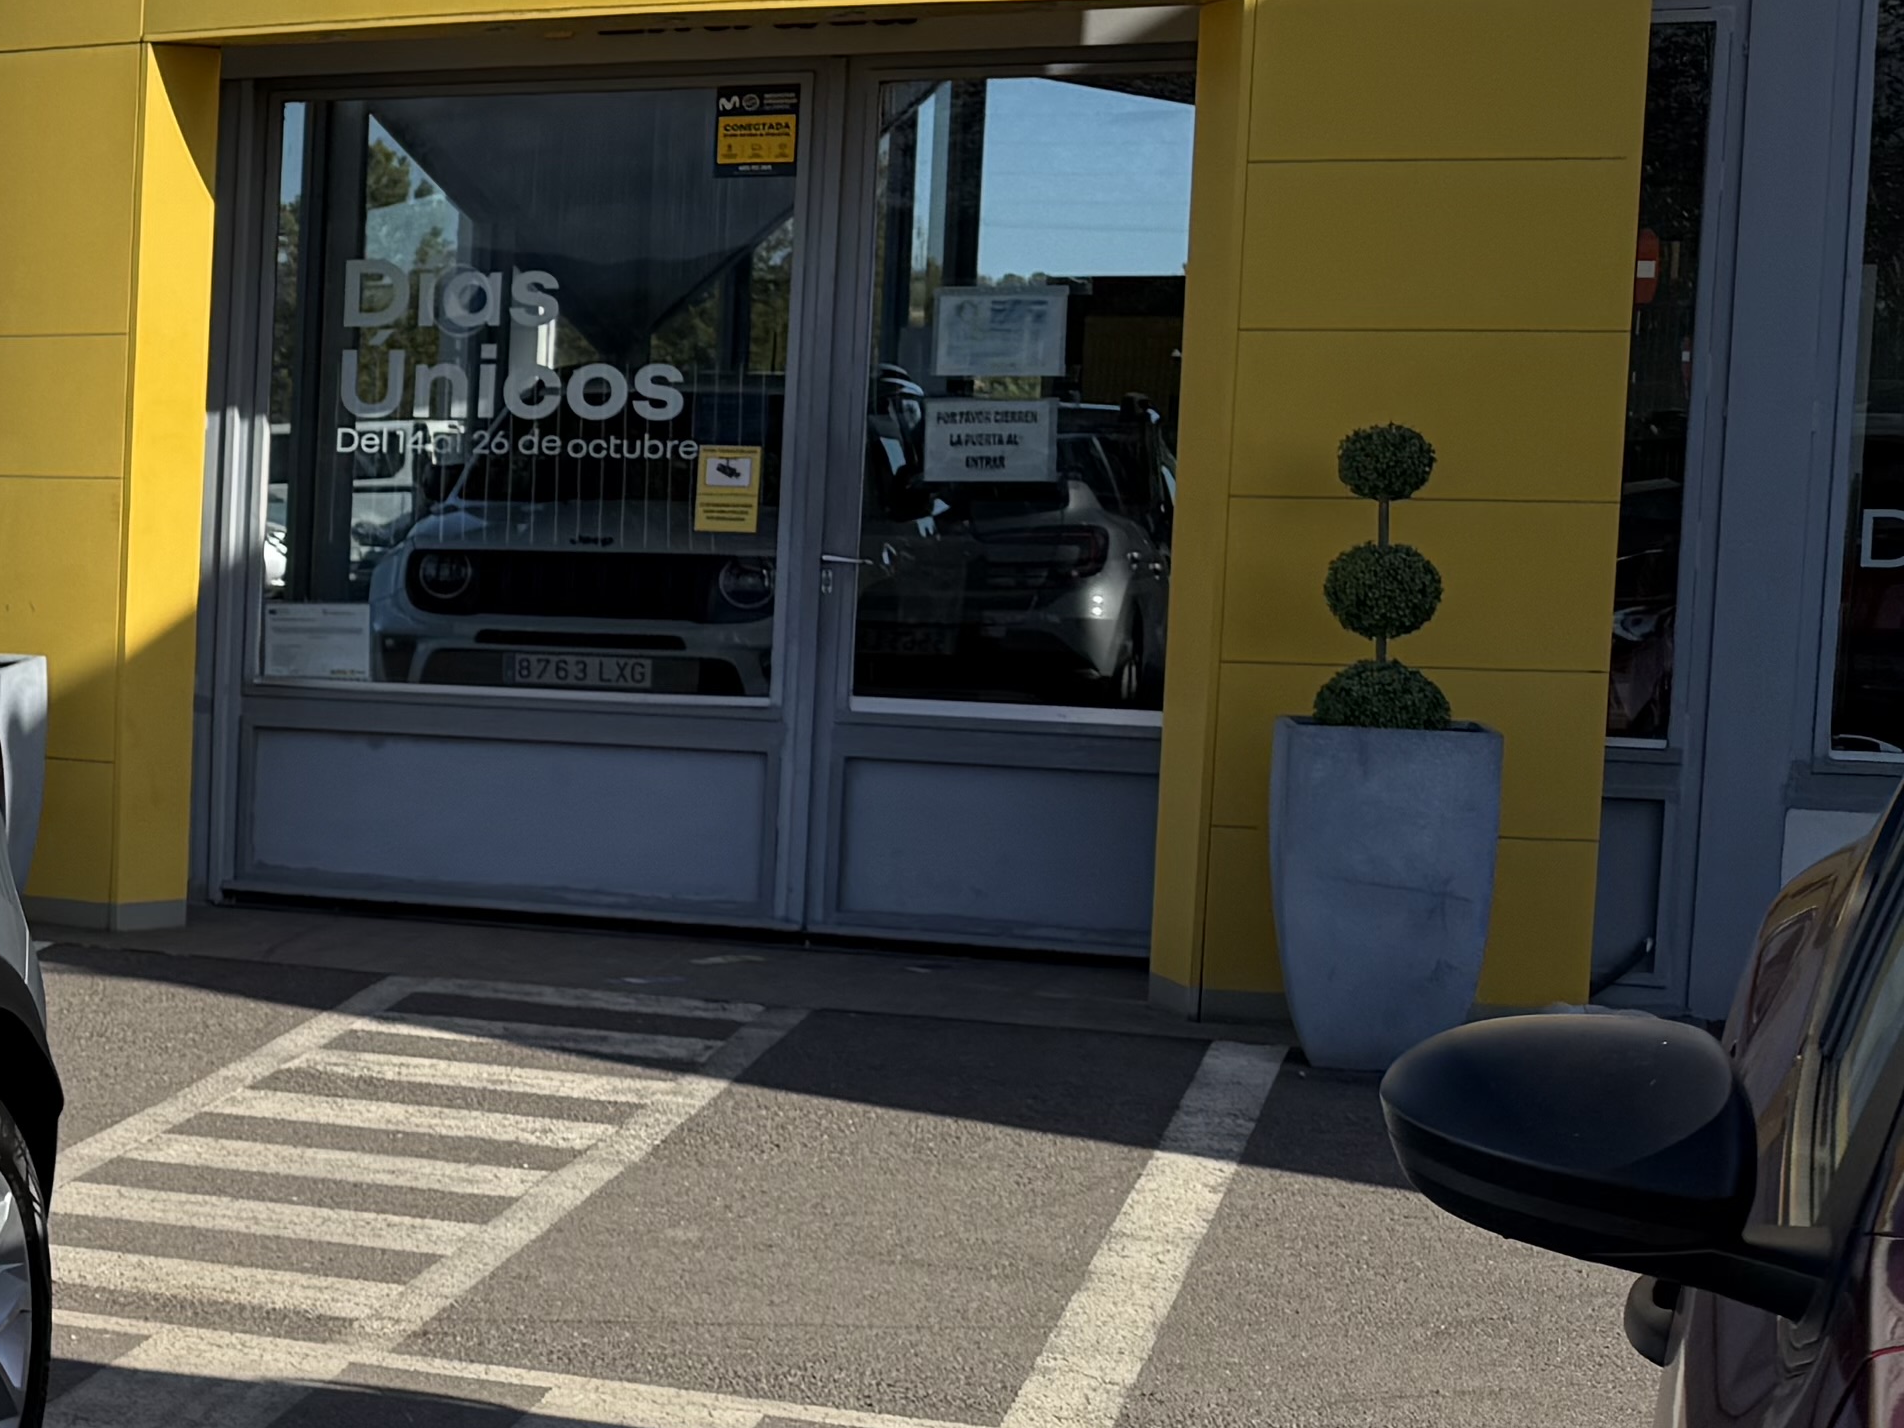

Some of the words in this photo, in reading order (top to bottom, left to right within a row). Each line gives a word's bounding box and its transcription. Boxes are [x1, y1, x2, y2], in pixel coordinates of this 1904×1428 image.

[341, 330, 685, 422] Únicos
[336, 427, 388, 454] Del
[396, 427, 428, 454] 14
[433, 427, 462, 454] al
[473, 429, 510, 455] 26
[518, 428, 562, 456] de
[567, 433, 699, 460] octubre
[949, 433, 963, 447] LA
[964, 433, 1004, 446] PUERTA
[965, 456, 1006, 469] ENTRAR
[517, 657, 588, 683] 8763
[598, 659, 646, 684] LXG
